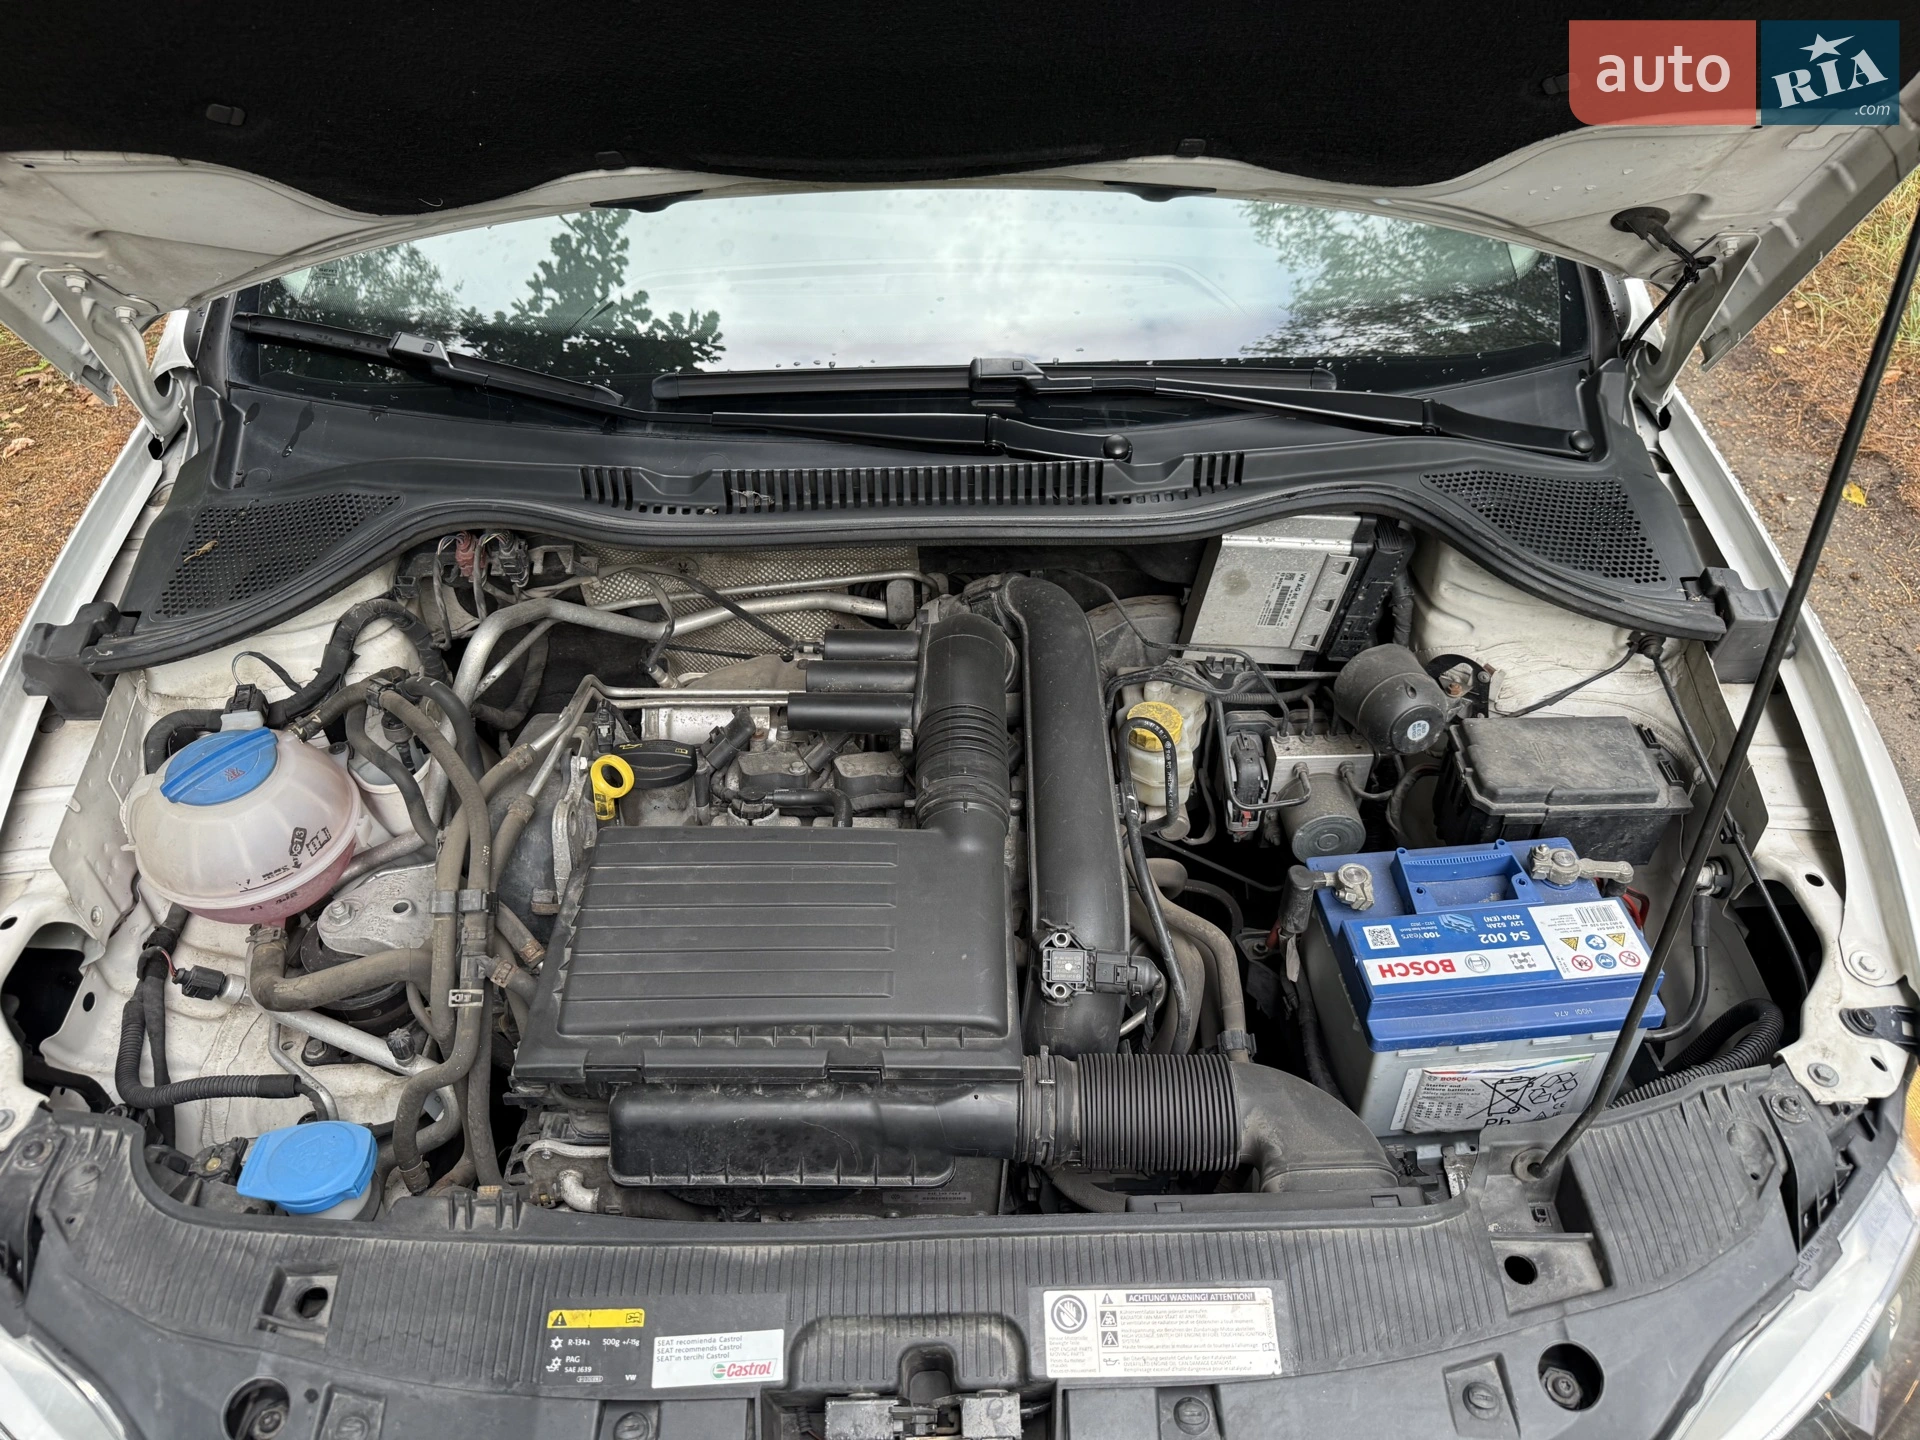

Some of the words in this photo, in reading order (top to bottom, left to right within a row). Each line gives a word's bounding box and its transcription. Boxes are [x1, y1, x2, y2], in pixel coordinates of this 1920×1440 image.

[1478, 932, 1507, 944] 002
[1510, 930, 1530, 941] S4
[1378, 958, 1456, 978] BOSCH
[1128, 1293, 1168, 1302] ACHTUNG!
[1169, 1293, 1208, 1302] WARNING!
[1210, 1292, 1253, 1301] ATTENTION!
[602, 1338, 620, 1347] 500g
[676, 1337, 717, 1345] recomienda
[675, 1345, 717, 1353] recommends
[727, 1362, 772, 1377] Castrol
